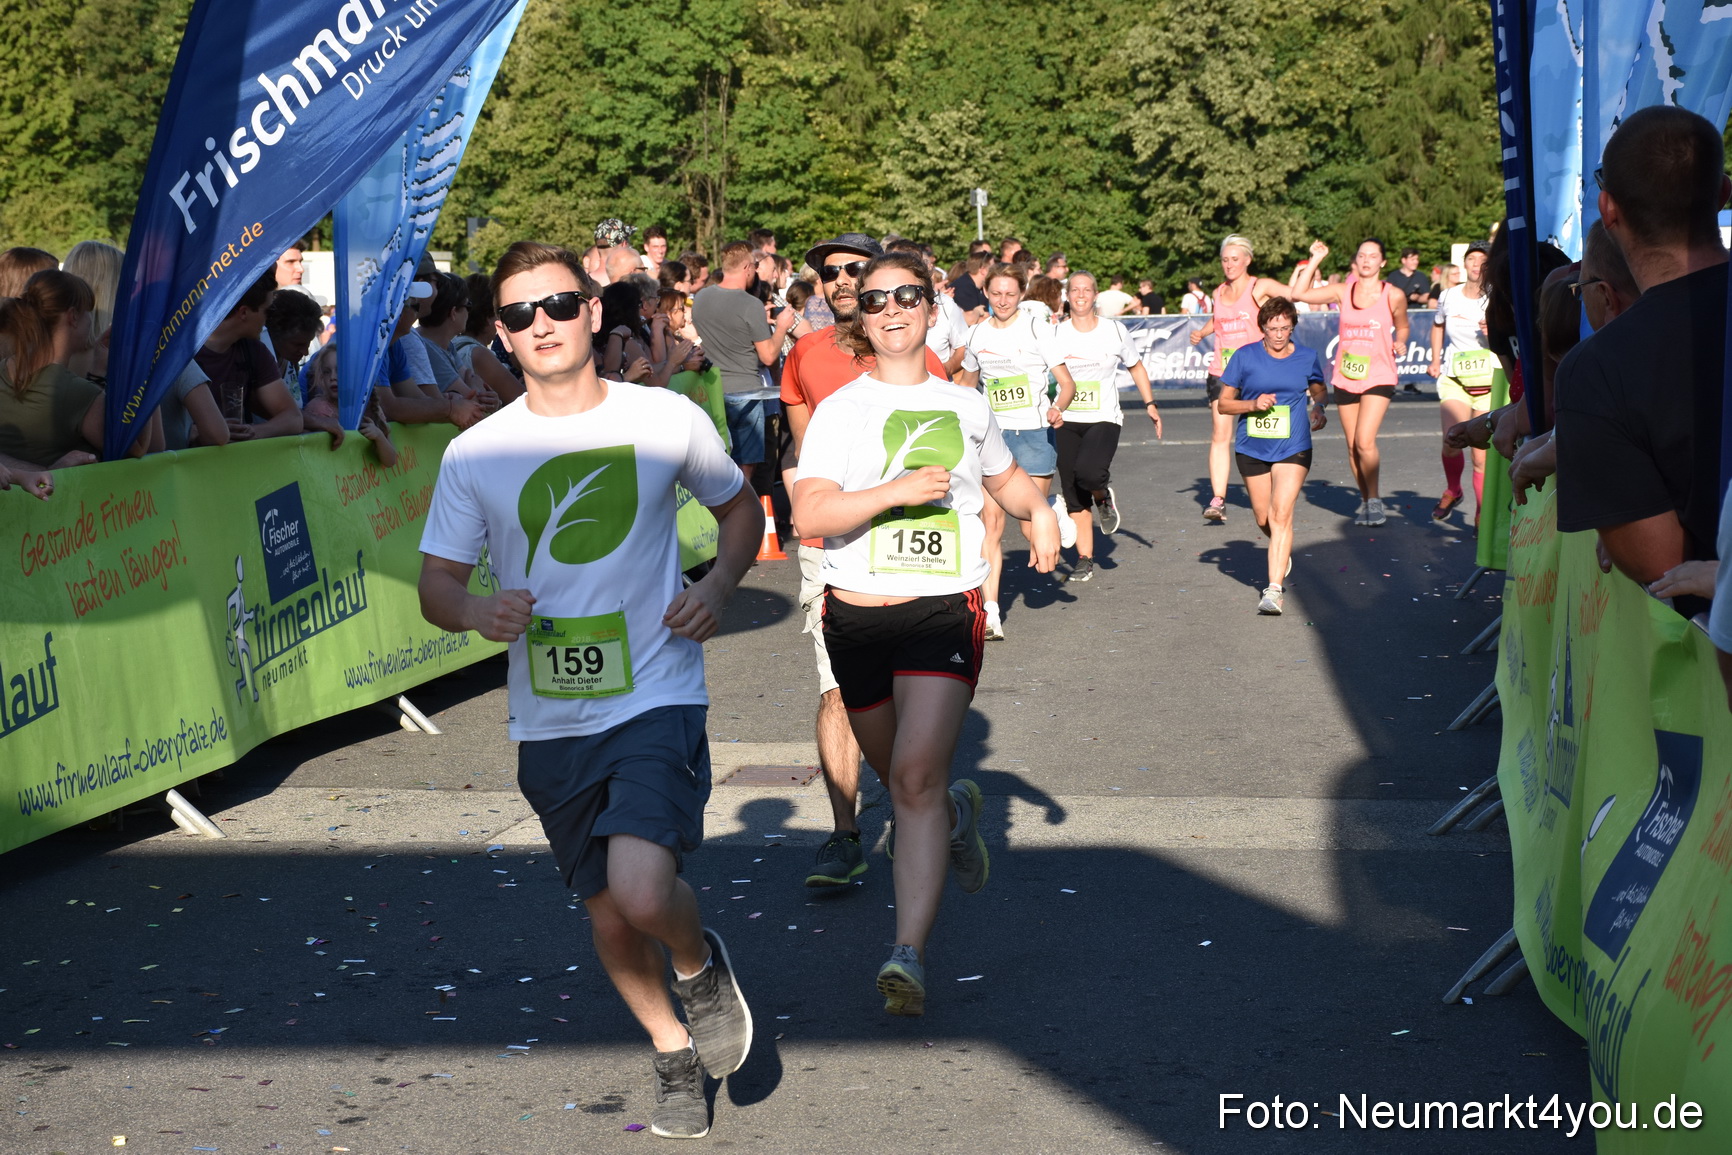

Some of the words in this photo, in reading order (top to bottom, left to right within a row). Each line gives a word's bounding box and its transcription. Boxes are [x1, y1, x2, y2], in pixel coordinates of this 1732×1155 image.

[341, 25, 408, 101] Druck
[1139, 346, 1215, 370] ische
[1343, 359, 1365, 373] 1450
[1458, 358, 1486, 370] 1817
[992, 387, 1025, 402] 1819
[1073, 391, 1094, 402] 821
[1255, 418, 1279, 429] 667
[335, 453, 381, 508] Gesunde
[20, 500, 98, 578] Gesunde
[99, 488, 159, 539] Firmen
[268, 519, 299, 548] Fischer
[366, 497, 405, 542] laufen
[274, 537, 300, 557] AUTOMOBILE
[892, 529, 943, 556] 158
[65, 558, 126, 620] laufen
[120, 519, 188, 592] länger!
[886, 554, 920, 562] Weinzierl
[921, 556, 947, 565] Shelley
[254, 549, 368, 667] firmenlauf
[262, 645, 309, 692] neumarkt
[546, 645, 604, 676] 159
[552, 676, 576, 685] Anhalt
[577, 676, 603, 684] Dieter
[17, 706, 228, 817] www.firmenlauf-oberpfalz.de
[1644, 800, 1685, 846] Fischer
